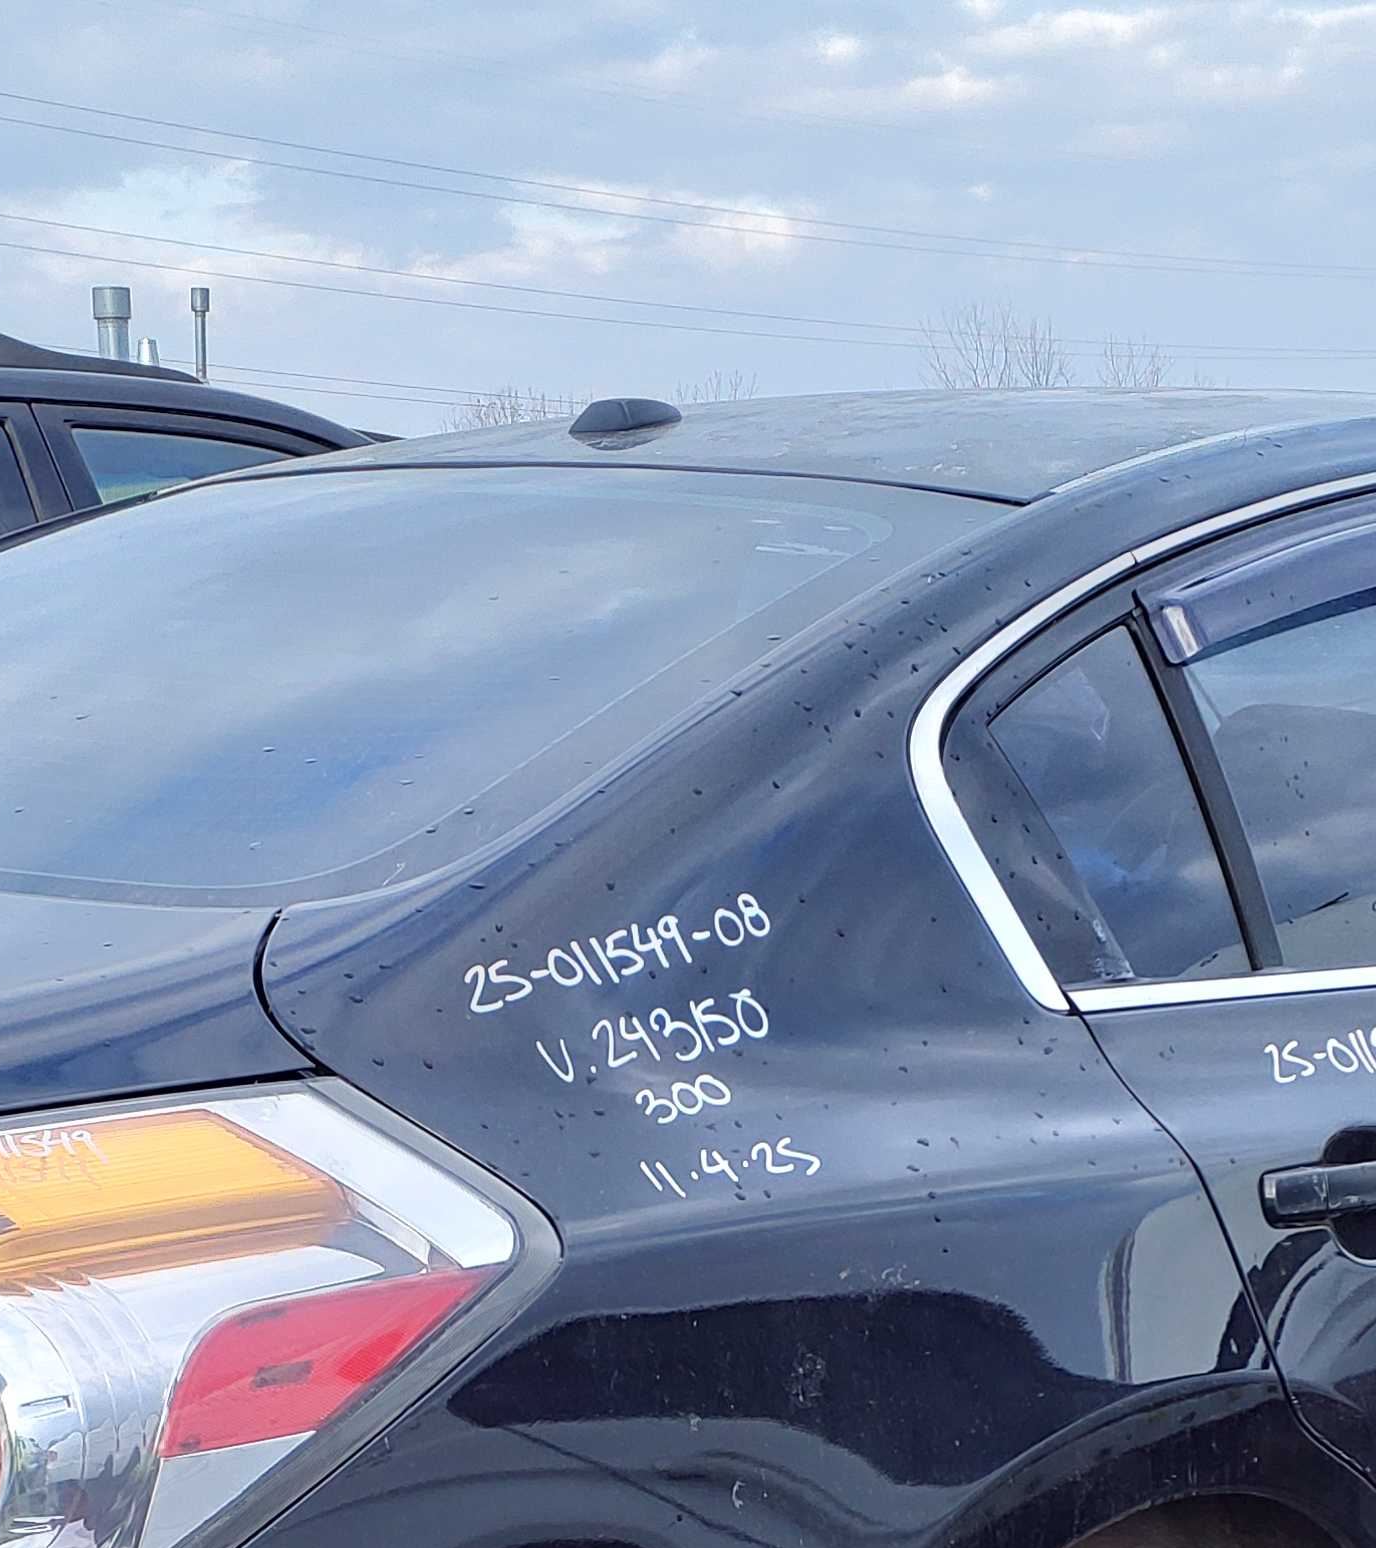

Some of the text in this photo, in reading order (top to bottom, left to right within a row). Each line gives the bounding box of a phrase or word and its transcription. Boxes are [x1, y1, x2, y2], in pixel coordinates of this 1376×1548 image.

[464, 893, 772, 1014] 25-011549-08
[634, 1073, 732, 1124] 300
[639, 1136, 822, 1199] 11.4.25
